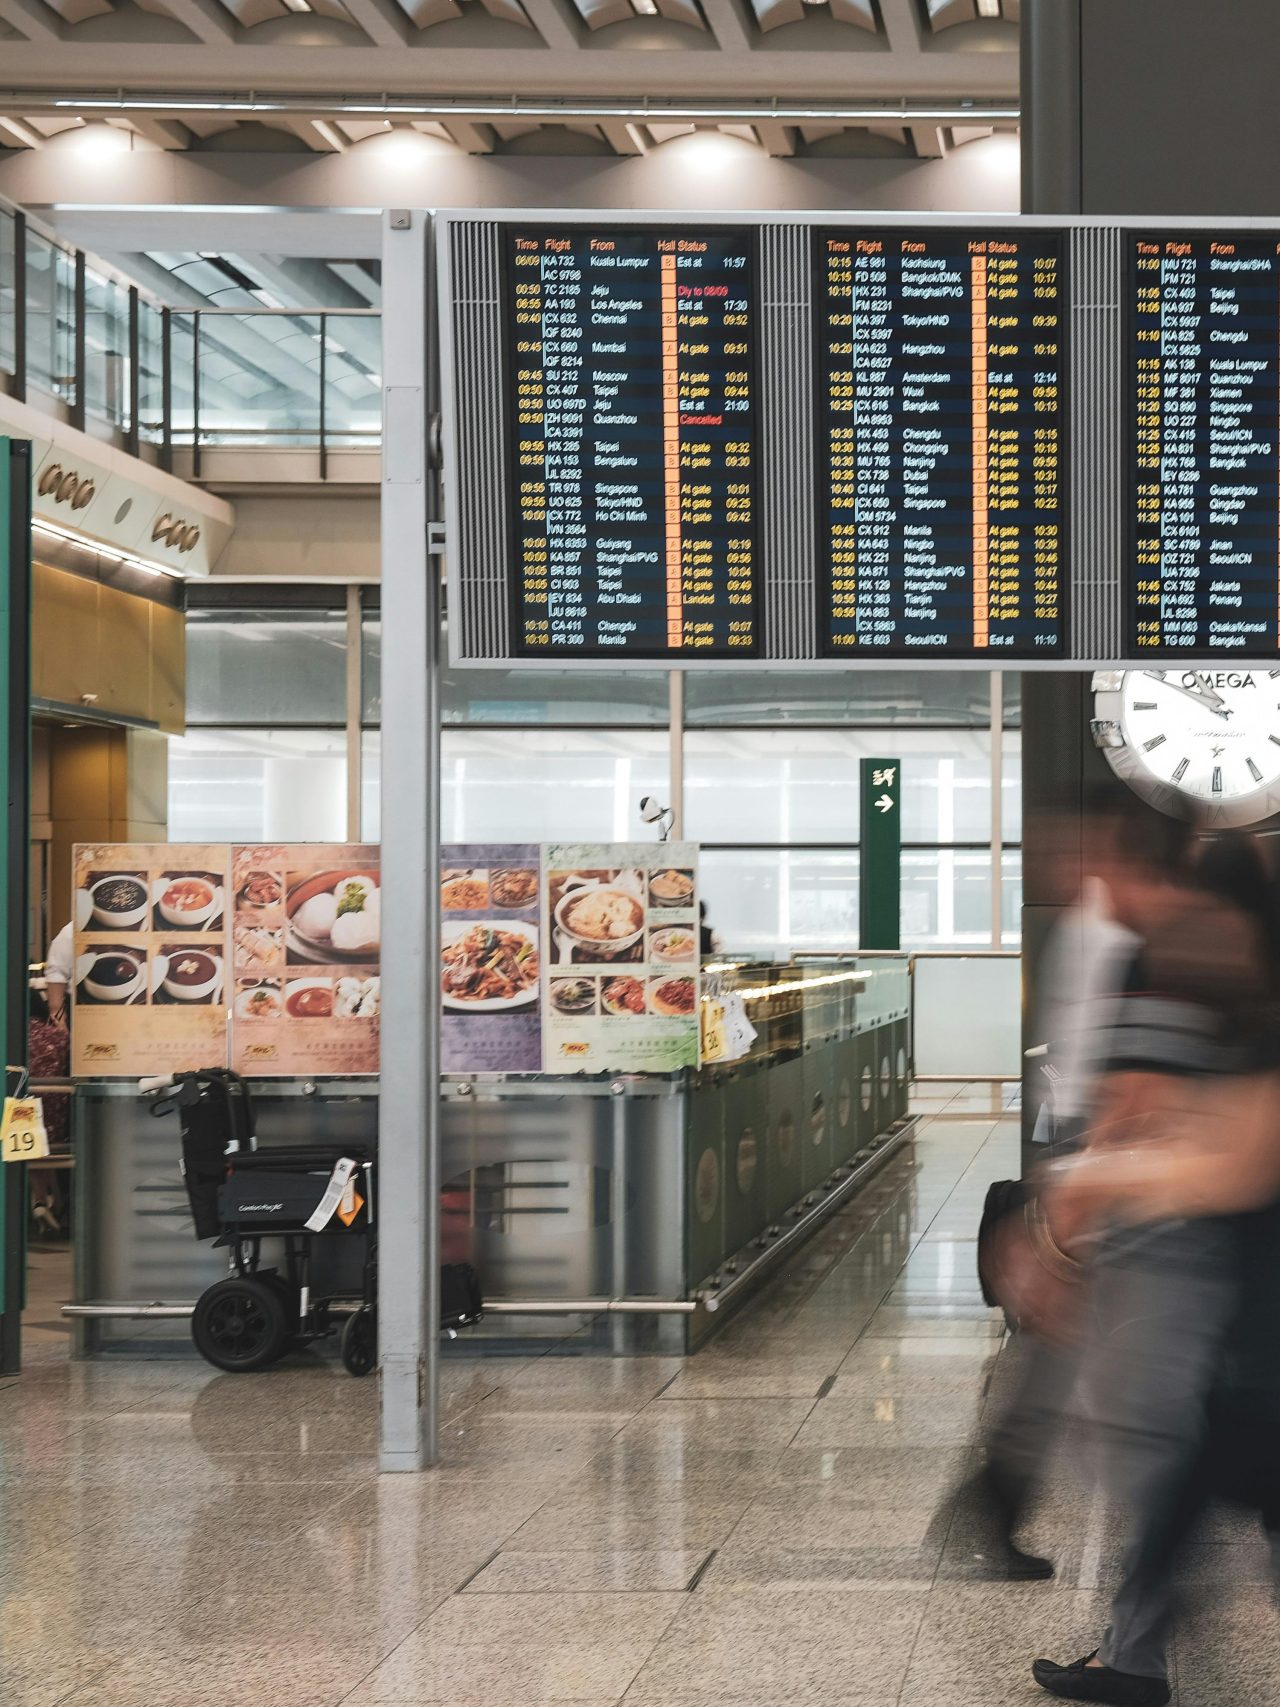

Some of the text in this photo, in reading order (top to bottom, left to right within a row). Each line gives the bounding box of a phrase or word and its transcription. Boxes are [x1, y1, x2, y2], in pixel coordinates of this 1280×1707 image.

[514, 238, 707, 252] Time Flight From Hall Status
[826, 239, 1017, 254] Time Flight From Hall Status
[1136, 242, 1159, 254] Time
[1165, 242, 1191, 256] Flight
[1210, 242, 1234, 254] From
[677, 256, 692, 267] Est
[692, 257, 702, 267] at
[987, 257, 997, 268] At
[998, 259, 1017, 271] gate
[590, 298, 607, 309] Los
[607, 298, 643, 312] Angeles
[678, 313, 688, 324] At
[688, 315, 708, 327] gate
[592, 370, 628, 381] Moscow
[679, 371, 689, 381] At
[689, 372, 709, 384] gate
[901, 371, 950, 382] Amsterdam
[988, 371, 1003, 383] Est
[1003, 372, 1013, 383] at
[1181, 671, 1257, 690] OMEGA
[9, 1131, 36, 1153] 19
